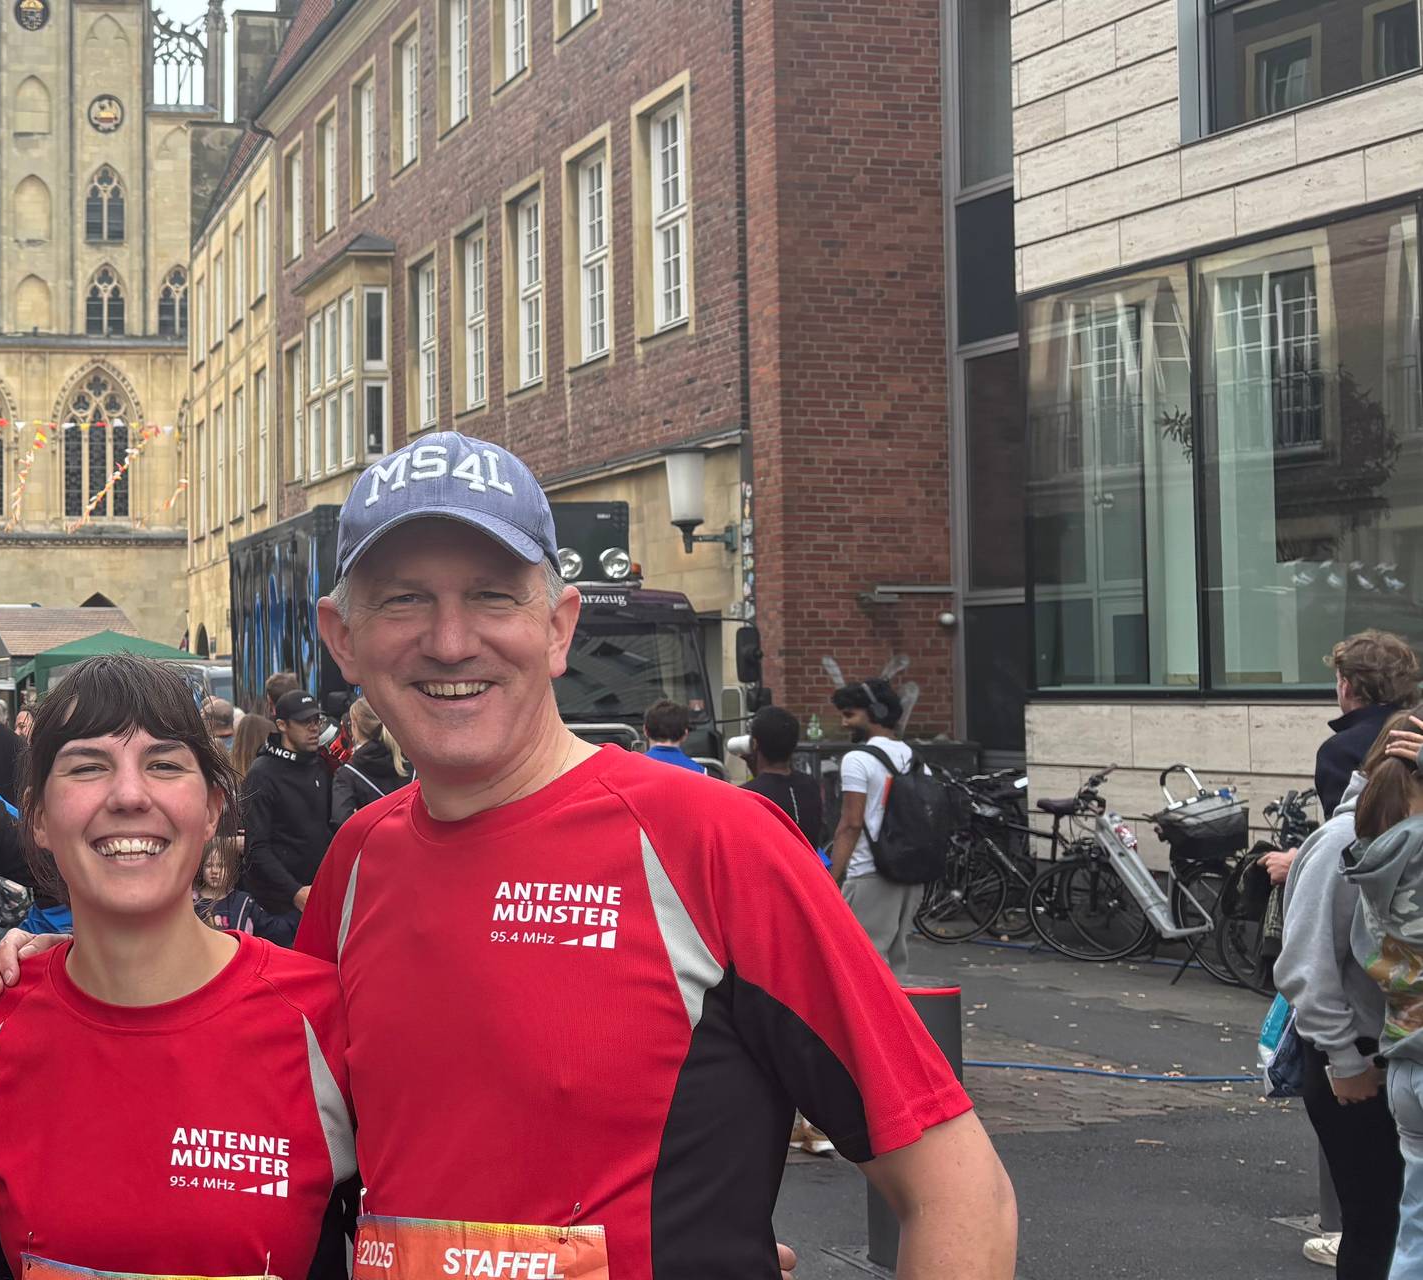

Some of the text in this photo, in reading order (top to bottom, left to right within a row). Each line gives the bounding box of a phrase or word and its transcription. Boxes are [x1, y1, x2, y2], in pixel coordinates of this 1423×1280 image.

[365, 446, 514, 507] MS4L
[494, 881, 622, 905] ANTENNE
[492, 901, 619, 928] MÜNSTER
[490, 930, 556, 945] 95.4 MHz
[172, 1127, 290, 1157] ANTENNE
[170, 1146, 289, 1178] MÜNSTER
[169, 1175, 236, 1191] 95.4 MHz
[360, 1239, 394, 1268] 2025
[443, 1247, 565, 1279] STAFFEL
